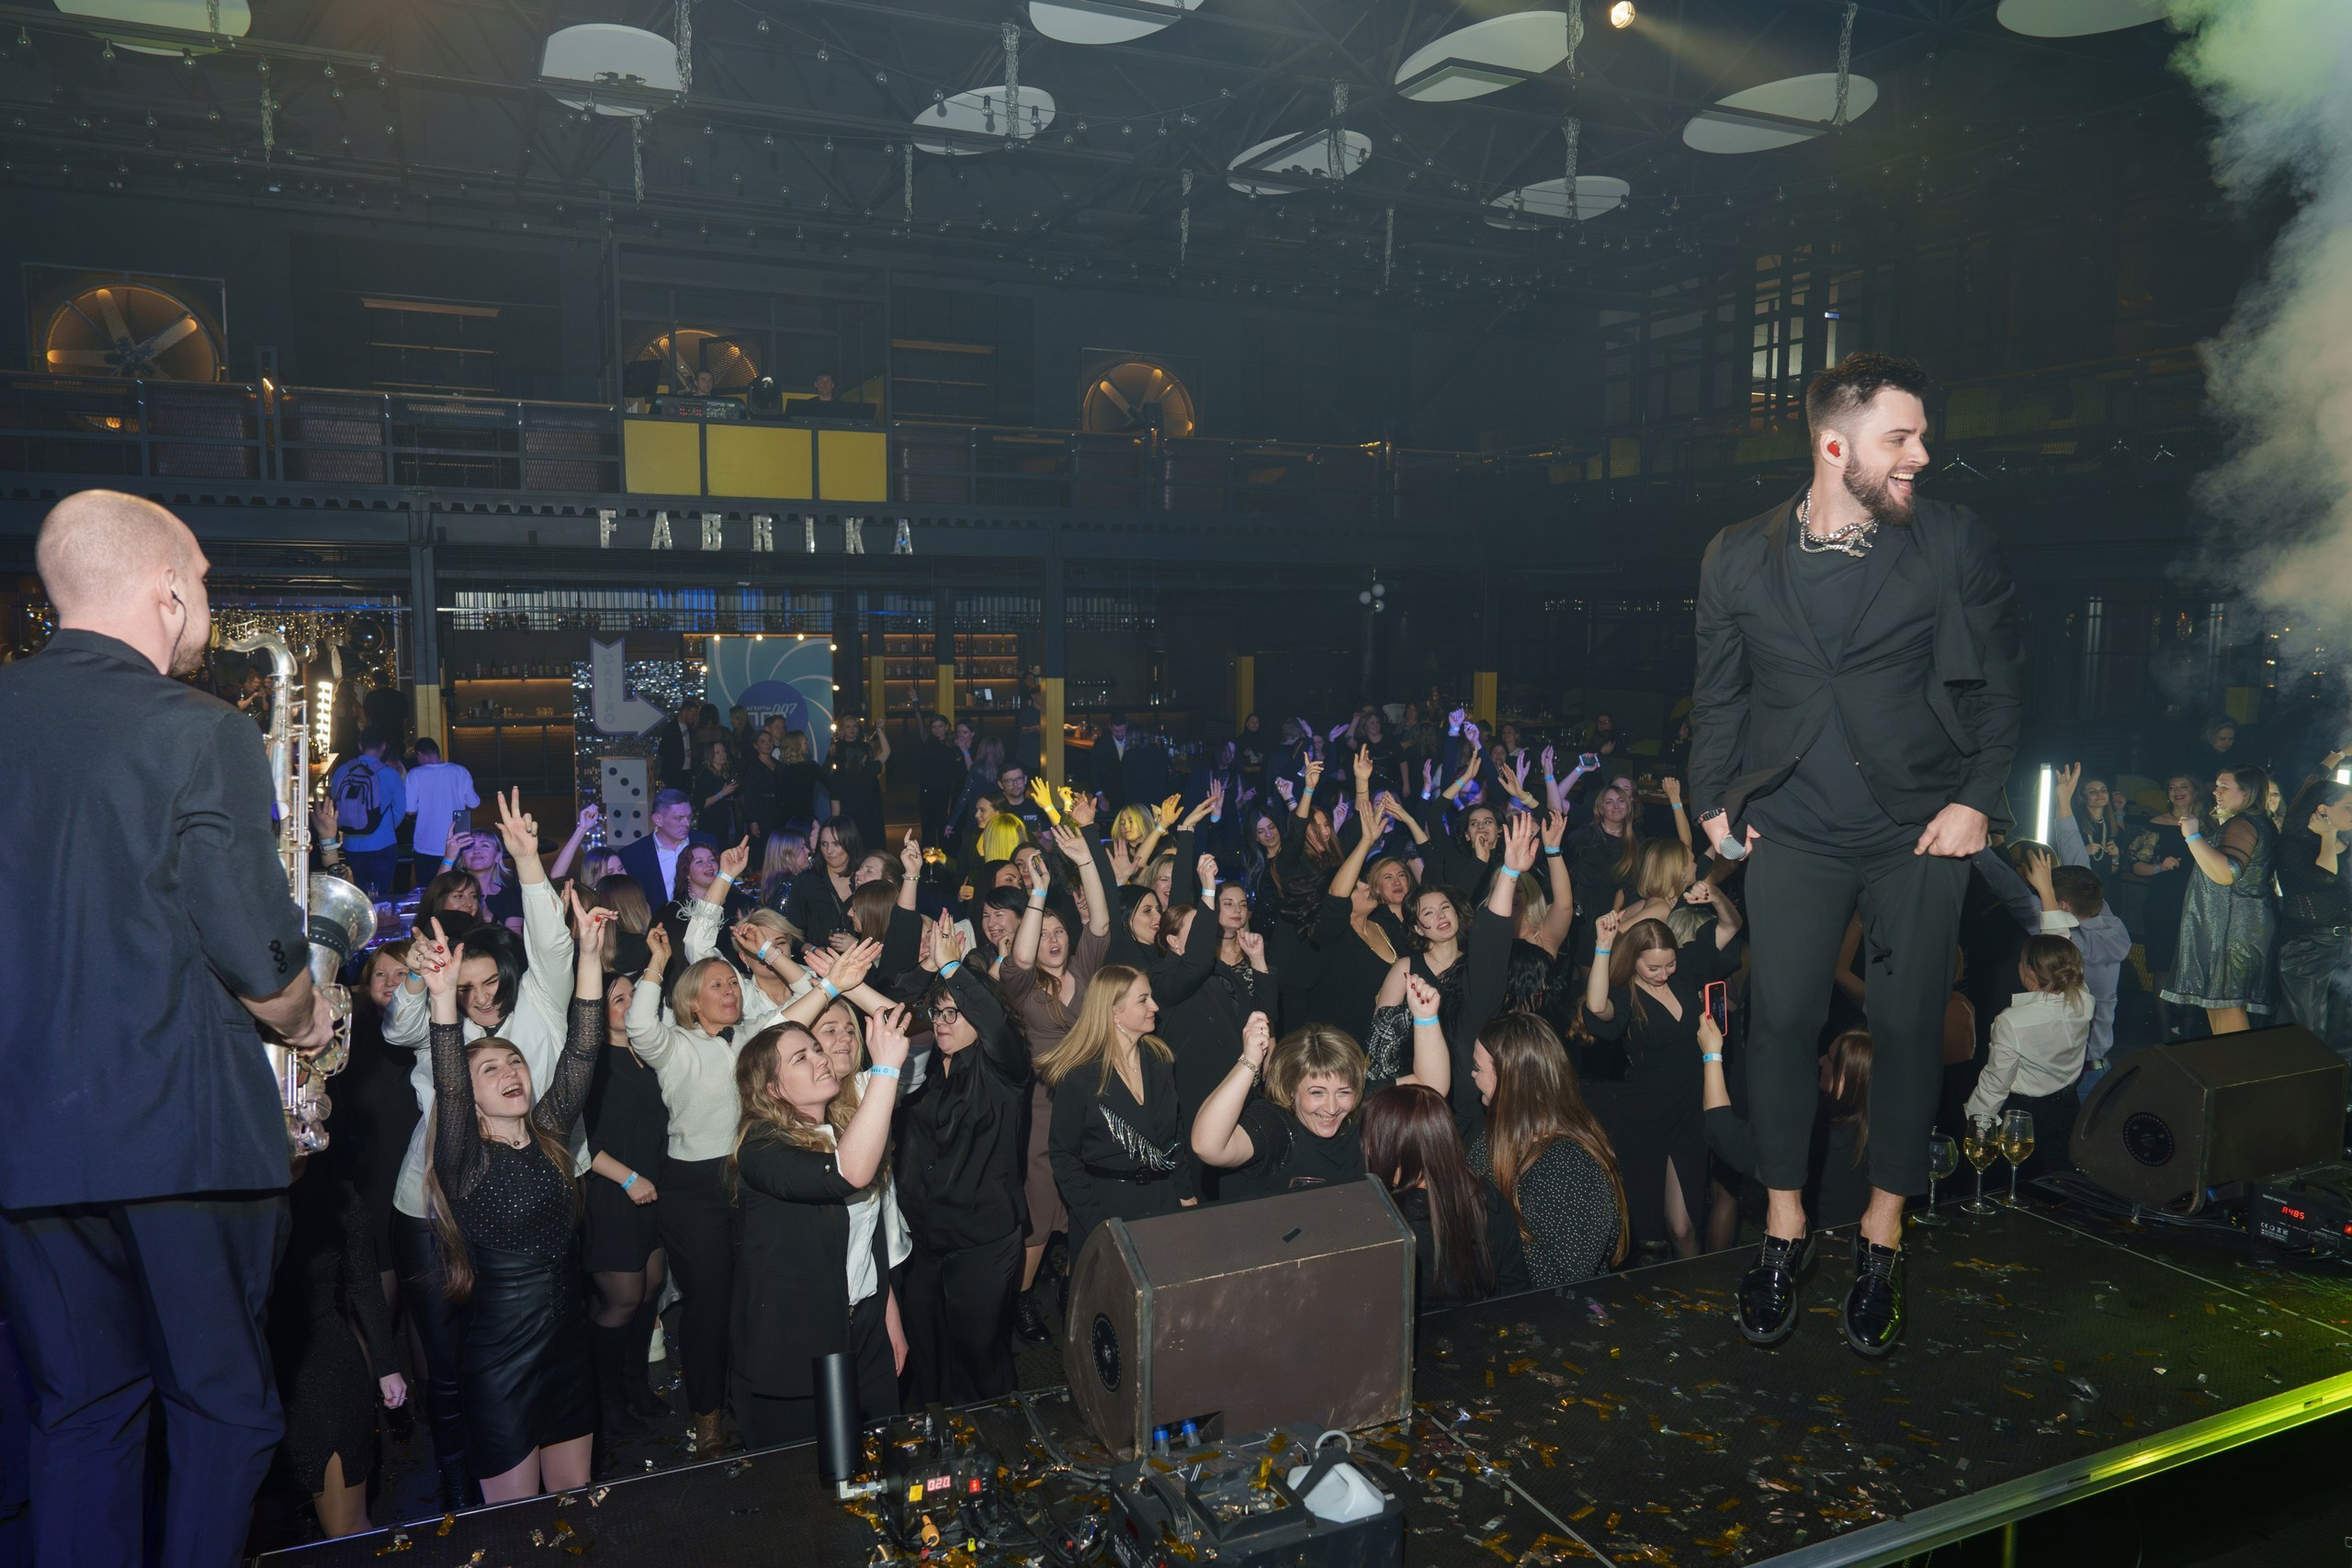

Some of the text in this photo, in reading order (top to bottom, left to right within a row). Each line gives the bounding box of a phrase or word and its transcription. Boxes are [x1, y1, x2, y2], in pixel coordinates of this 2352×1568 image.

[599, 509, 913, 555] FABRIKA
[603, 653, 616, 724] CASINO
[773, 703, 797, 715] 007
[927, 1475, 951, 1492] 020
